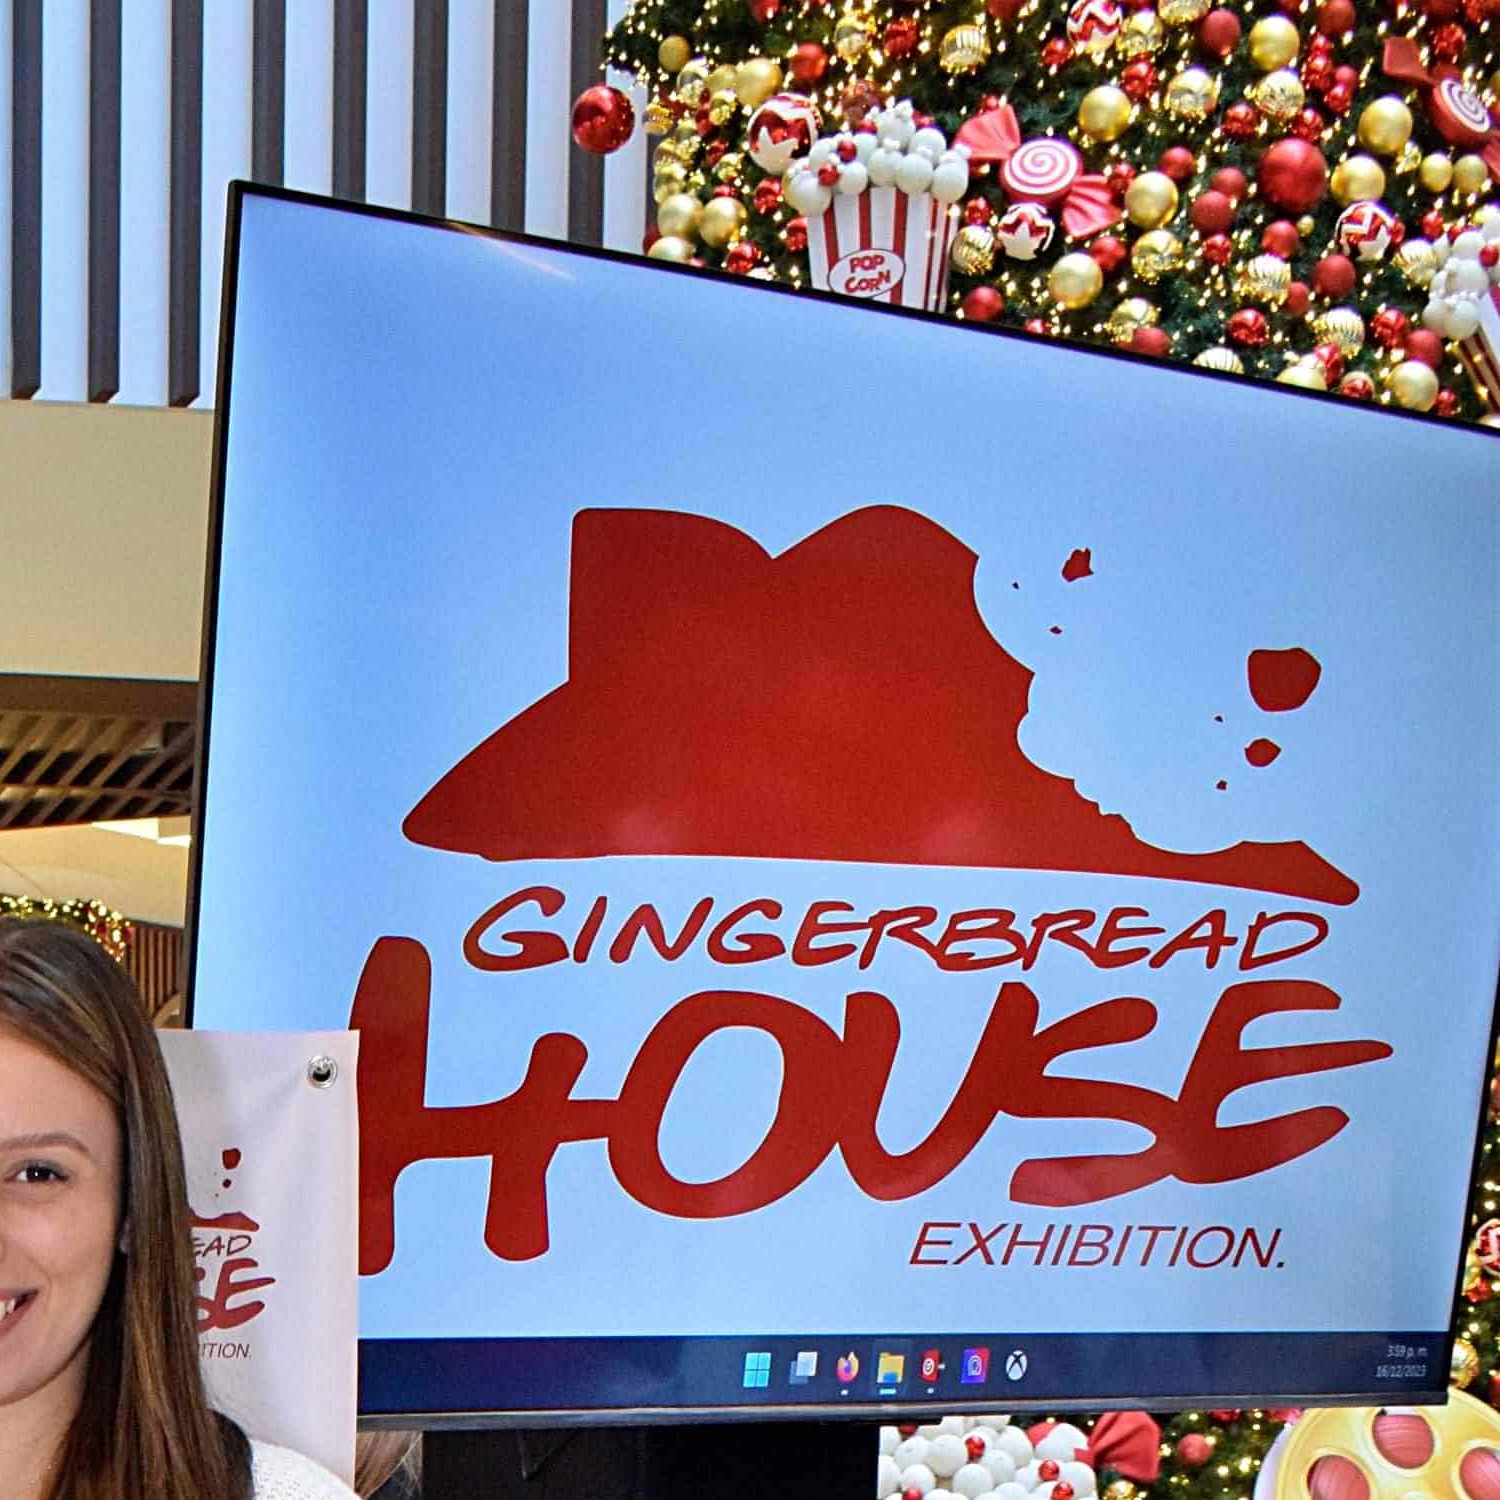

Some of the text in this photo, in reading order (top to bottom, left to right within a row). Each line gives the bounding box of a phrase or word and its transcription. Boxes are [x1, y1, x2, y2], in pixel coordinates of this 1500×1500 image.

[844, 269, 891, 294] CORN
[850, 254, 886, 274] POP
[463, 884, 1328, 972] GINGERBREAD
[348, 935, 1394, 1276] HOUSE
[909, 1222, 1287, 1269] EXHIBITION.
